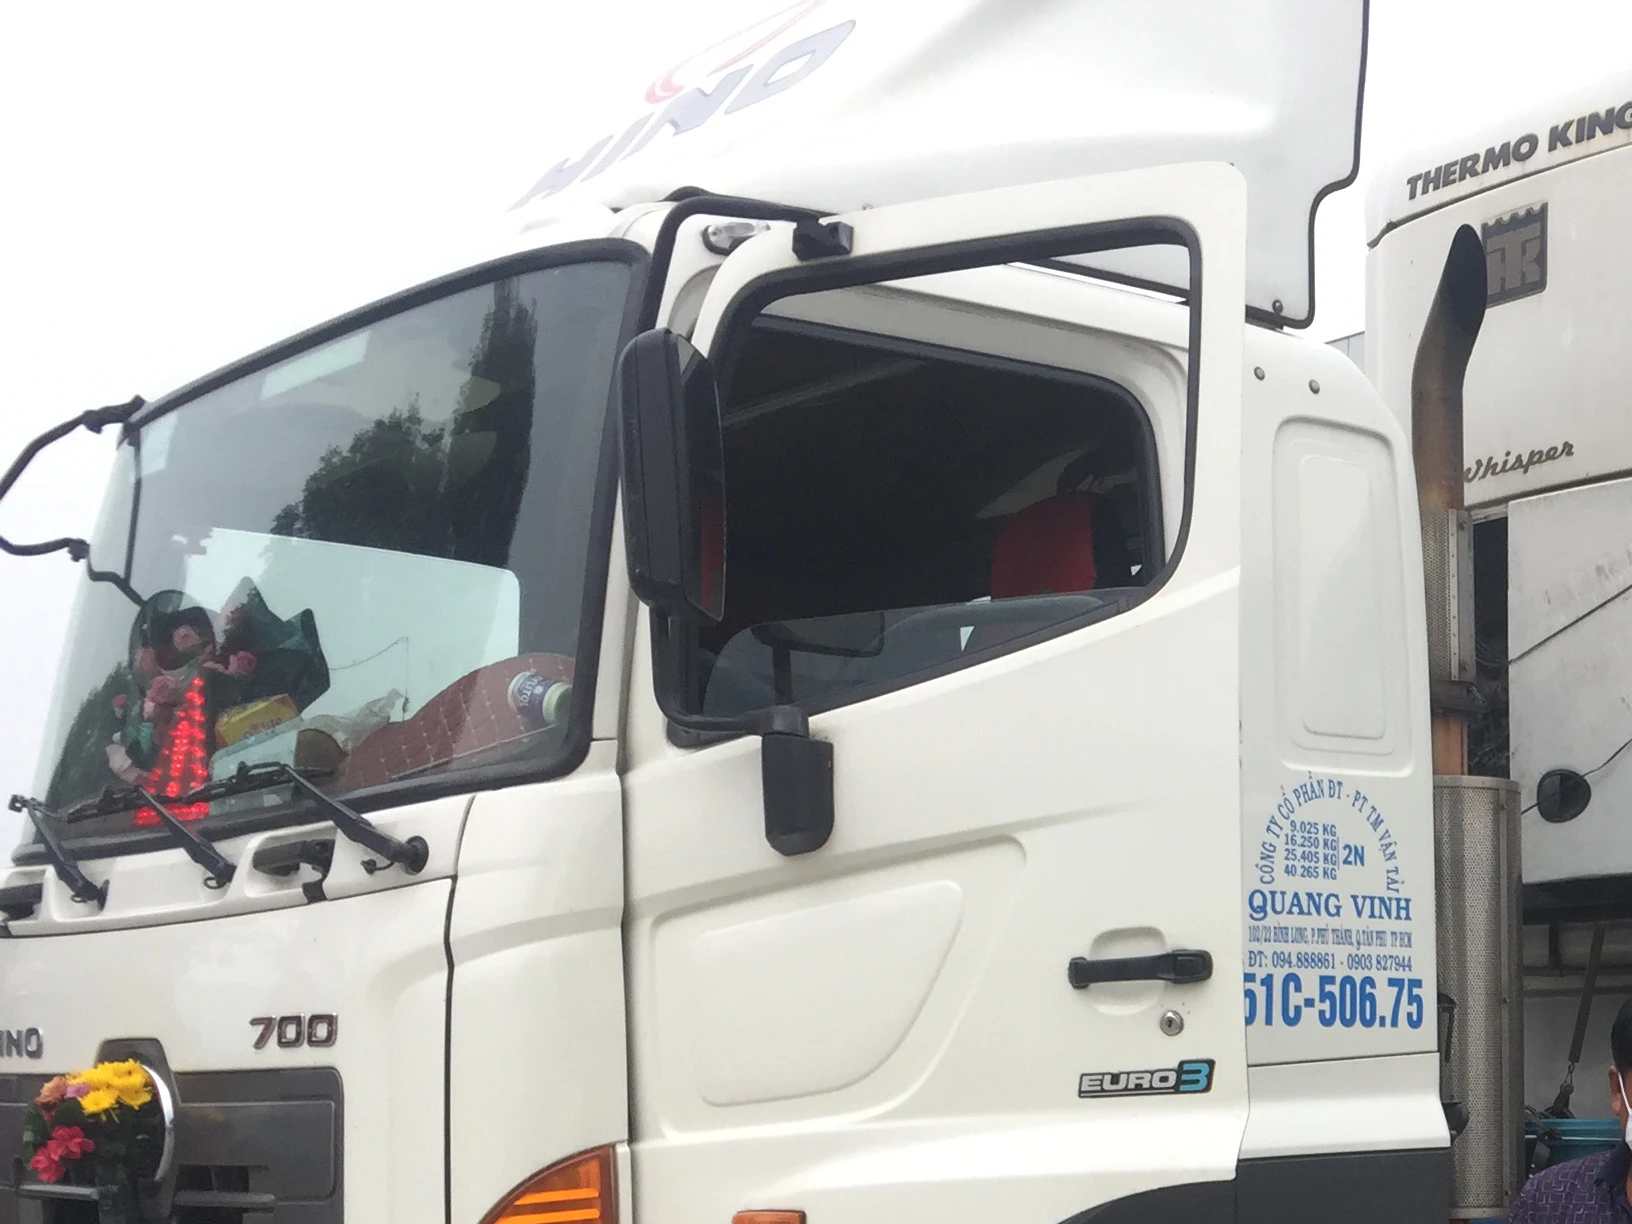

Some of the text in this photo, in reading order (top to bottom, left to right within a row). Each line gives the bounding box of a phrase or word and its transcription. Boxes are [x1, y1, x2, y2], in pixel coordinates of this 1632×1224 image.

[1406, 132, 1540, 201] THERMO
[1327, 778, 1344, 800] ĐT
[1351, 789, 1369, 813] PT
[1266, 815, 1284, 839] TY
[1289, 820, 1337, 837] 9.025 KG
[1366, 805, 1385, 833] TM
[1283, 833, 1337, 851] 16.250 KG
[1255, 841, 1278, 886] CÔNG
[1283, 848, 1337, 866] 25.405 KG
[1342, 843, 1365, 867] 2N
[1283, 864, 1337, 880] 40.265 KG
[1248, 888, 1412, 922] QUANG VINH
[1248, 950, 1268, 968] ĐT:
[1347, 952, 1373, 971] 0903
[1375, 953, 1413, 972] 827944
[1244, 972, 1424, 1030] 51C-506.75
[249, 1011, 338, 1050] 700
